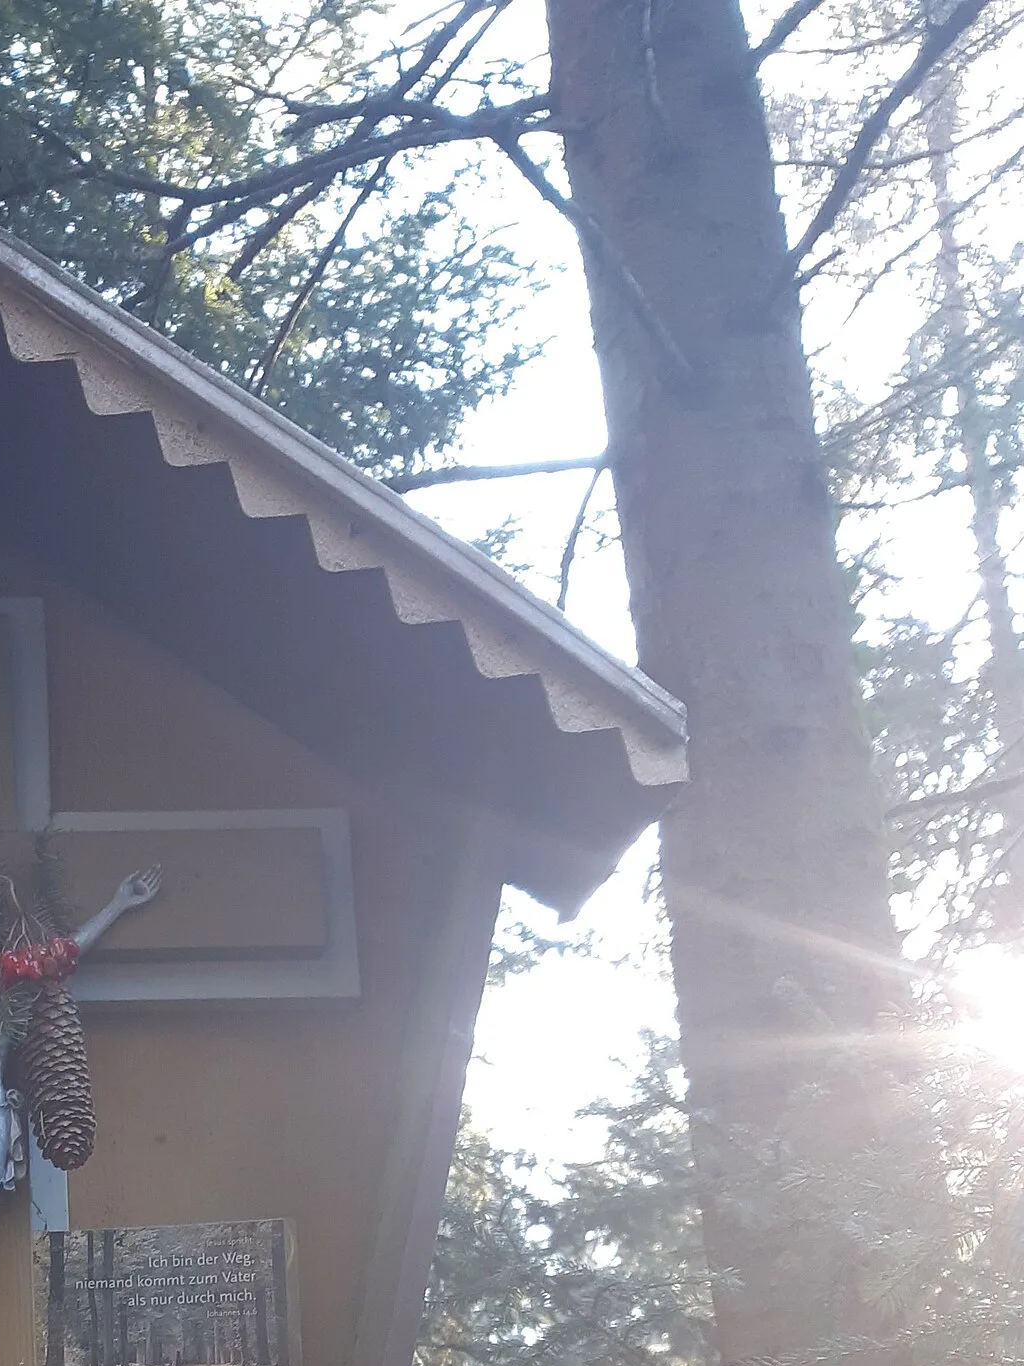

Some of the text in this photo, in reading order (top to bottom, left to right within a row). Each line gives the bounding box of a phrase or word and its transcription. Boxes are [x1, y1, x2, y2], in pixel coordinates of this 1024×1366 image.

[148, 1251, 255, 1268] Ich bin der Weg,
[76, 1271, 256, 1289] niemand kommt zum Vater
[128, 1288, 257, 1306] als nur durch mich.
[207, 1309, 240, 1318] Johannes
